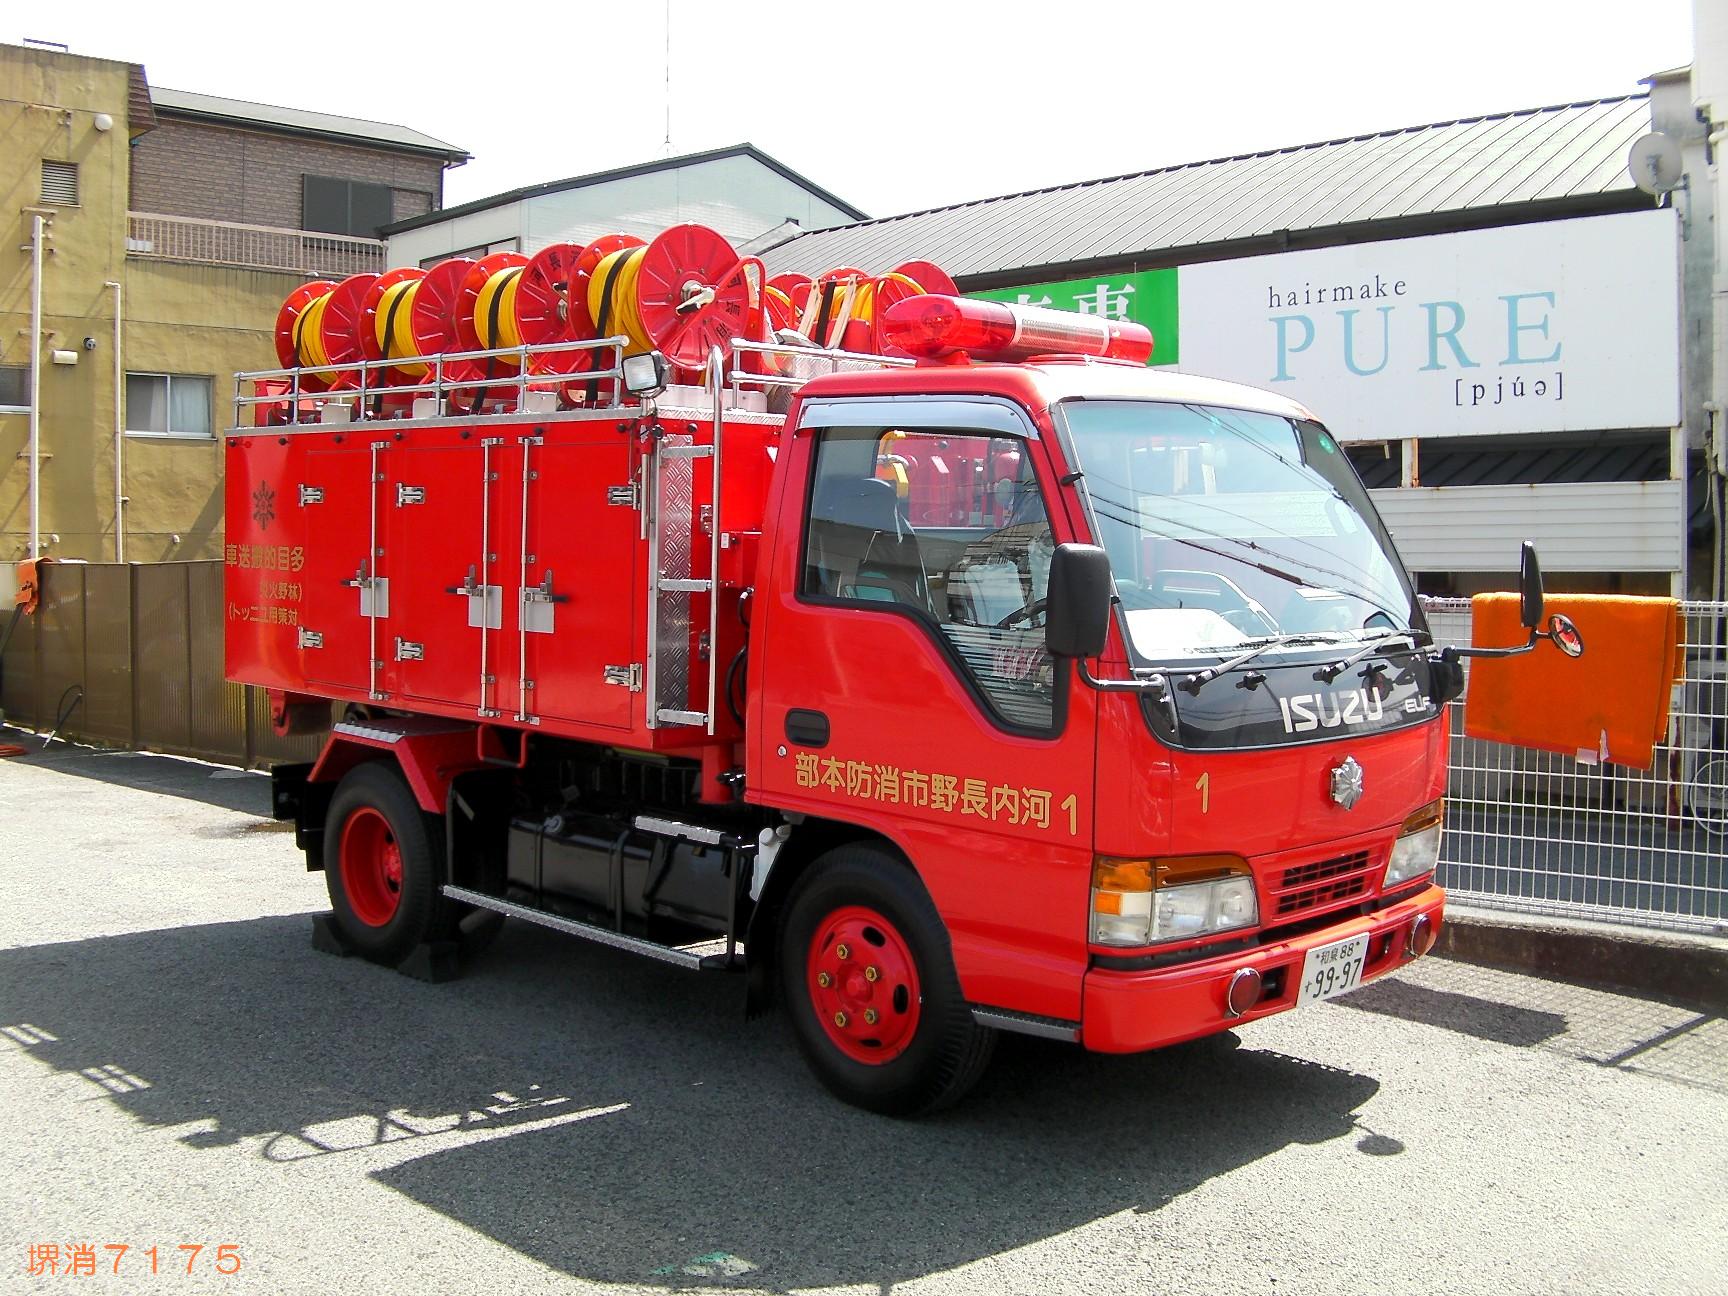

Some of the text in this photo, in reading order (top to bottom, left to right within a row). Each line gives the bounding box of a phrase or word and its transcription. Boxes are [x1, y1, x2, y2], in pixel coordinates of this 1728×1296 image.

[1268, 274, 1407, 308] hairmake
[1268, 291, 1562, 382] PURE
[1279, 686, 1384, 734] ISUZU
[1195, 772, 1210, 814] 1
[1061, 793, 1078, 836] 1
[1312, 958, 1362, 999] 99-97
